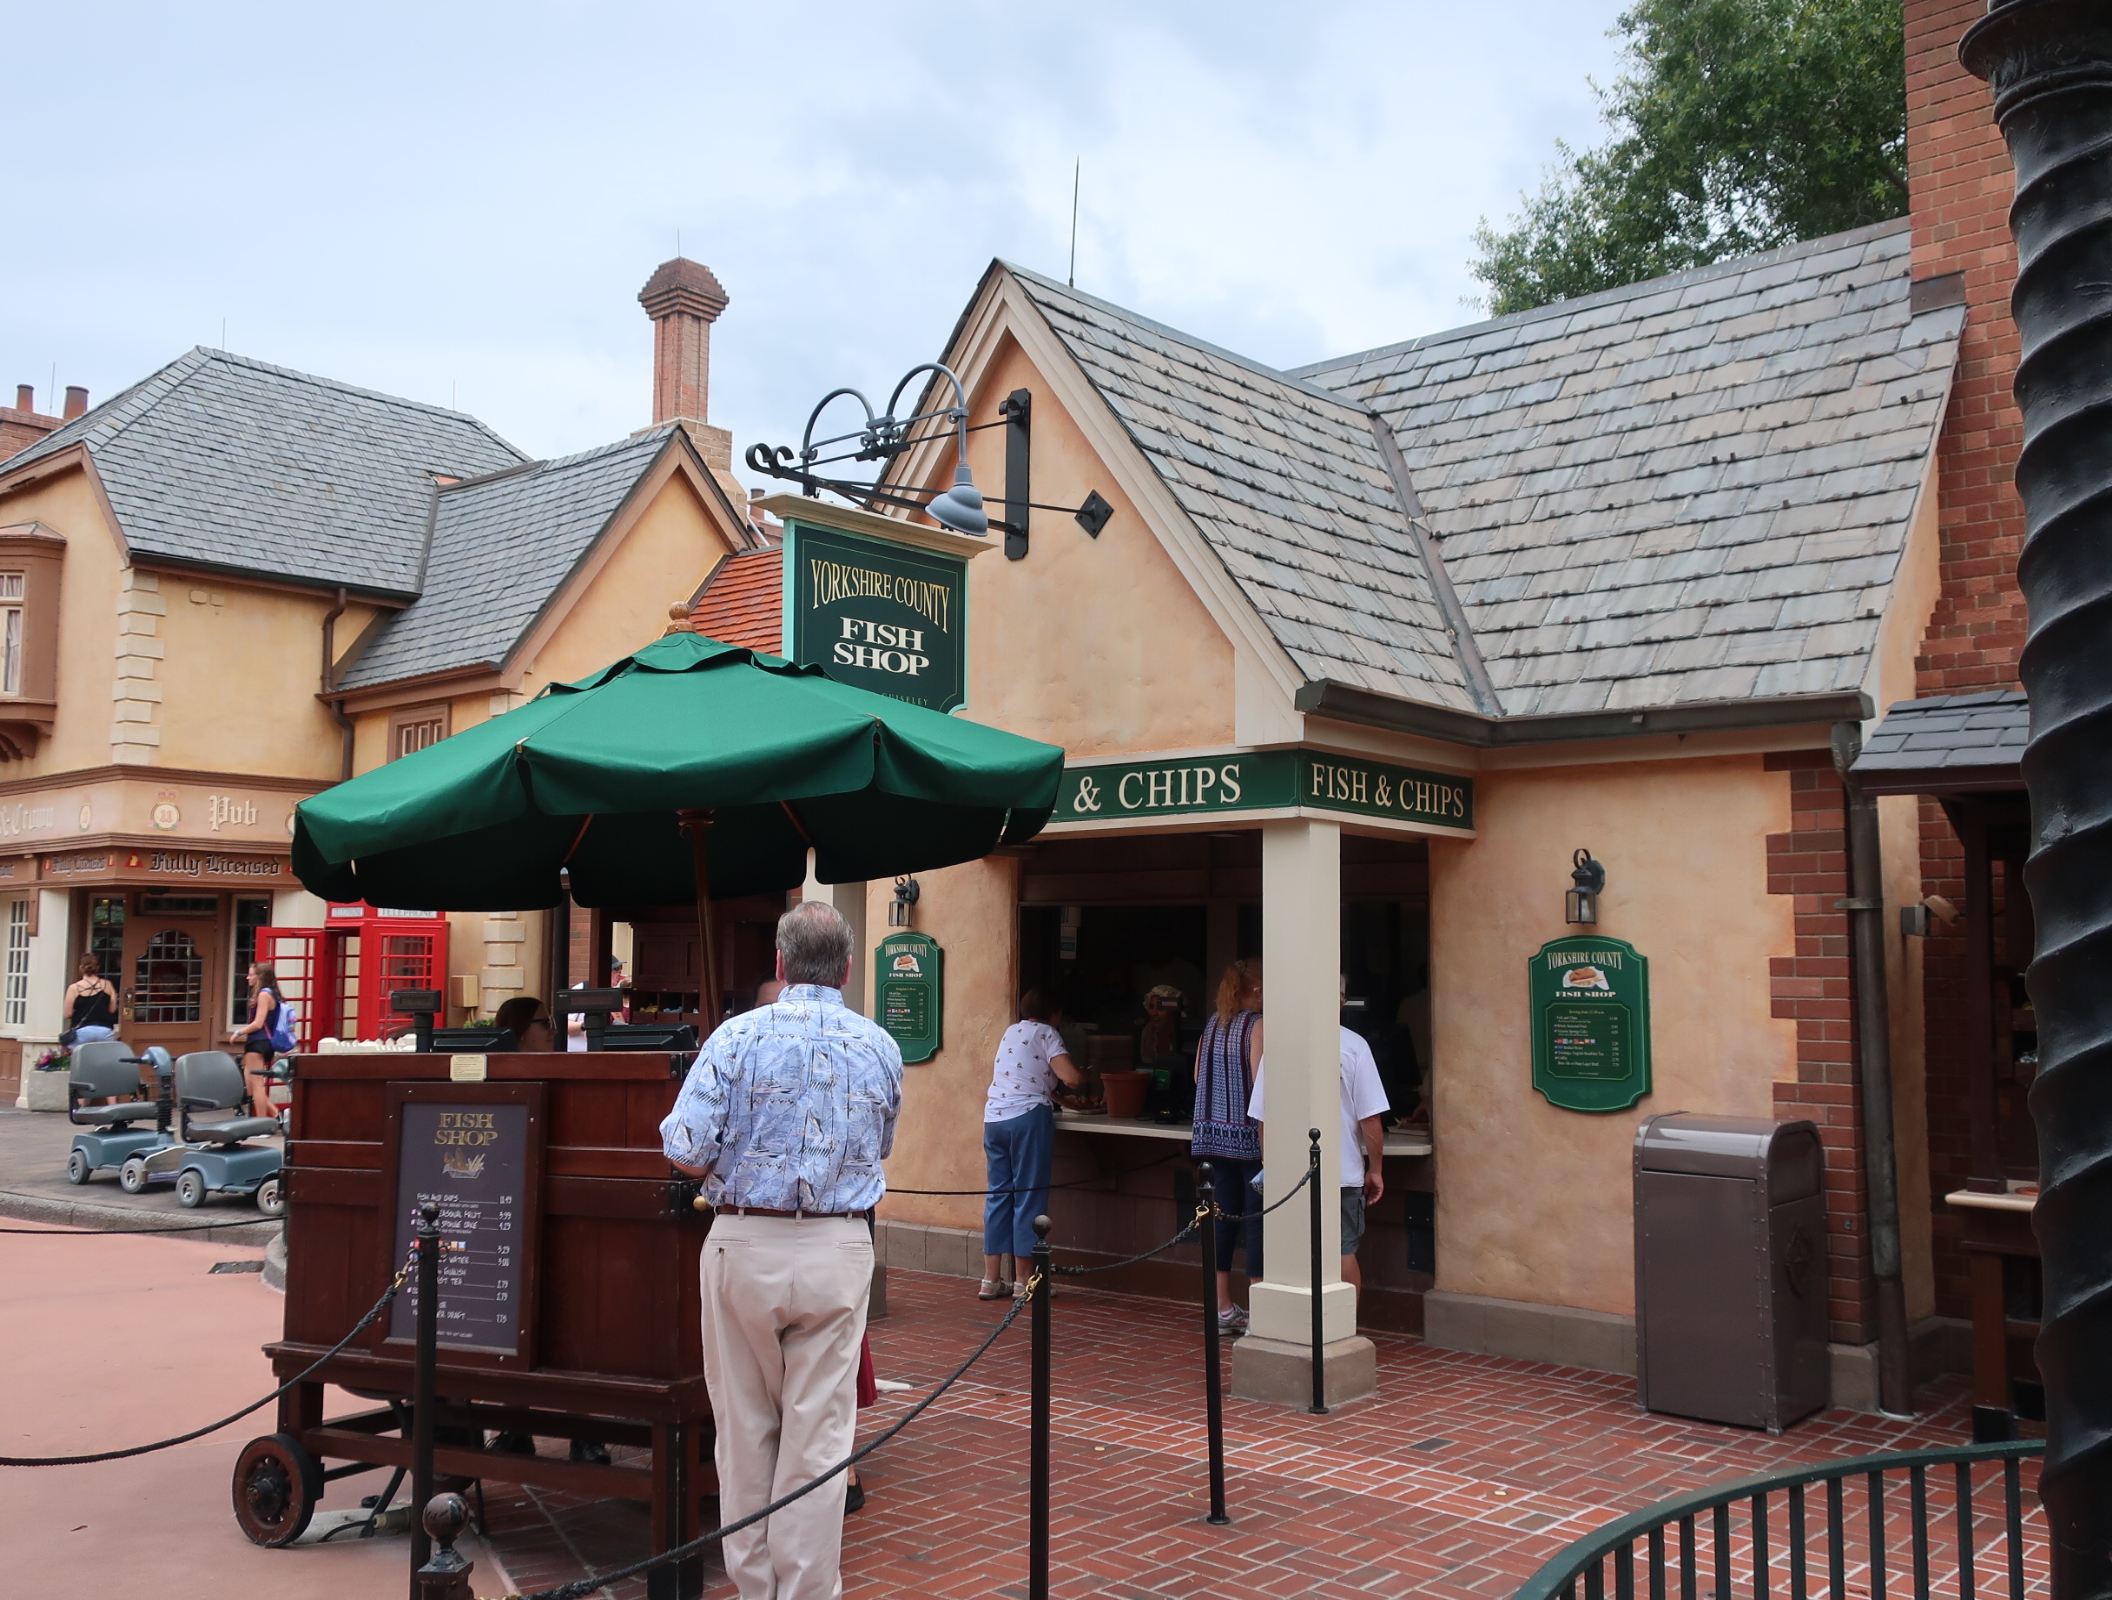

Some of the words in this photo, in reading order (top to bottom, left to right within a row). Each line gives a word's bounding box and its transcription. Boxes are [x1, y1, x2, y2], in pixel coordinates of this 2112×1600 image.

[811, 559, 893, 610] YORKSHIRE
[894, 577, 950, 634] COUNTY
[840, 616, 925, 652] FISH
[833, 642, 930, 676] SHOP
[1073, 775, 1102, 812] &
[1118, 763, 1241, 810] CHIPS
[1311, 762, 1368, 804] FISH
[1374, 774, 1394, 808] &
[1398, 778, 1464, 819] CHIPS
[209, 794, 259, 832] Pub
[149, 852, 201, 878] Fully
[205, 855, 281, 877] Licensed
[885, 944, 909, 958] YORKSHIRE
[909, 944, 928, 958] COUNTY
[1547, 952, 1590, 970] YORKSHIRE
[1591, 952, 1623, 970] COUNTY
[438, 1113, 495, 1129] FISH
[434, 1130, 499, 1146] SHOP
[448, 1255, 470, 1265] WATER
[450, 1277, 463, 1286] TEA
